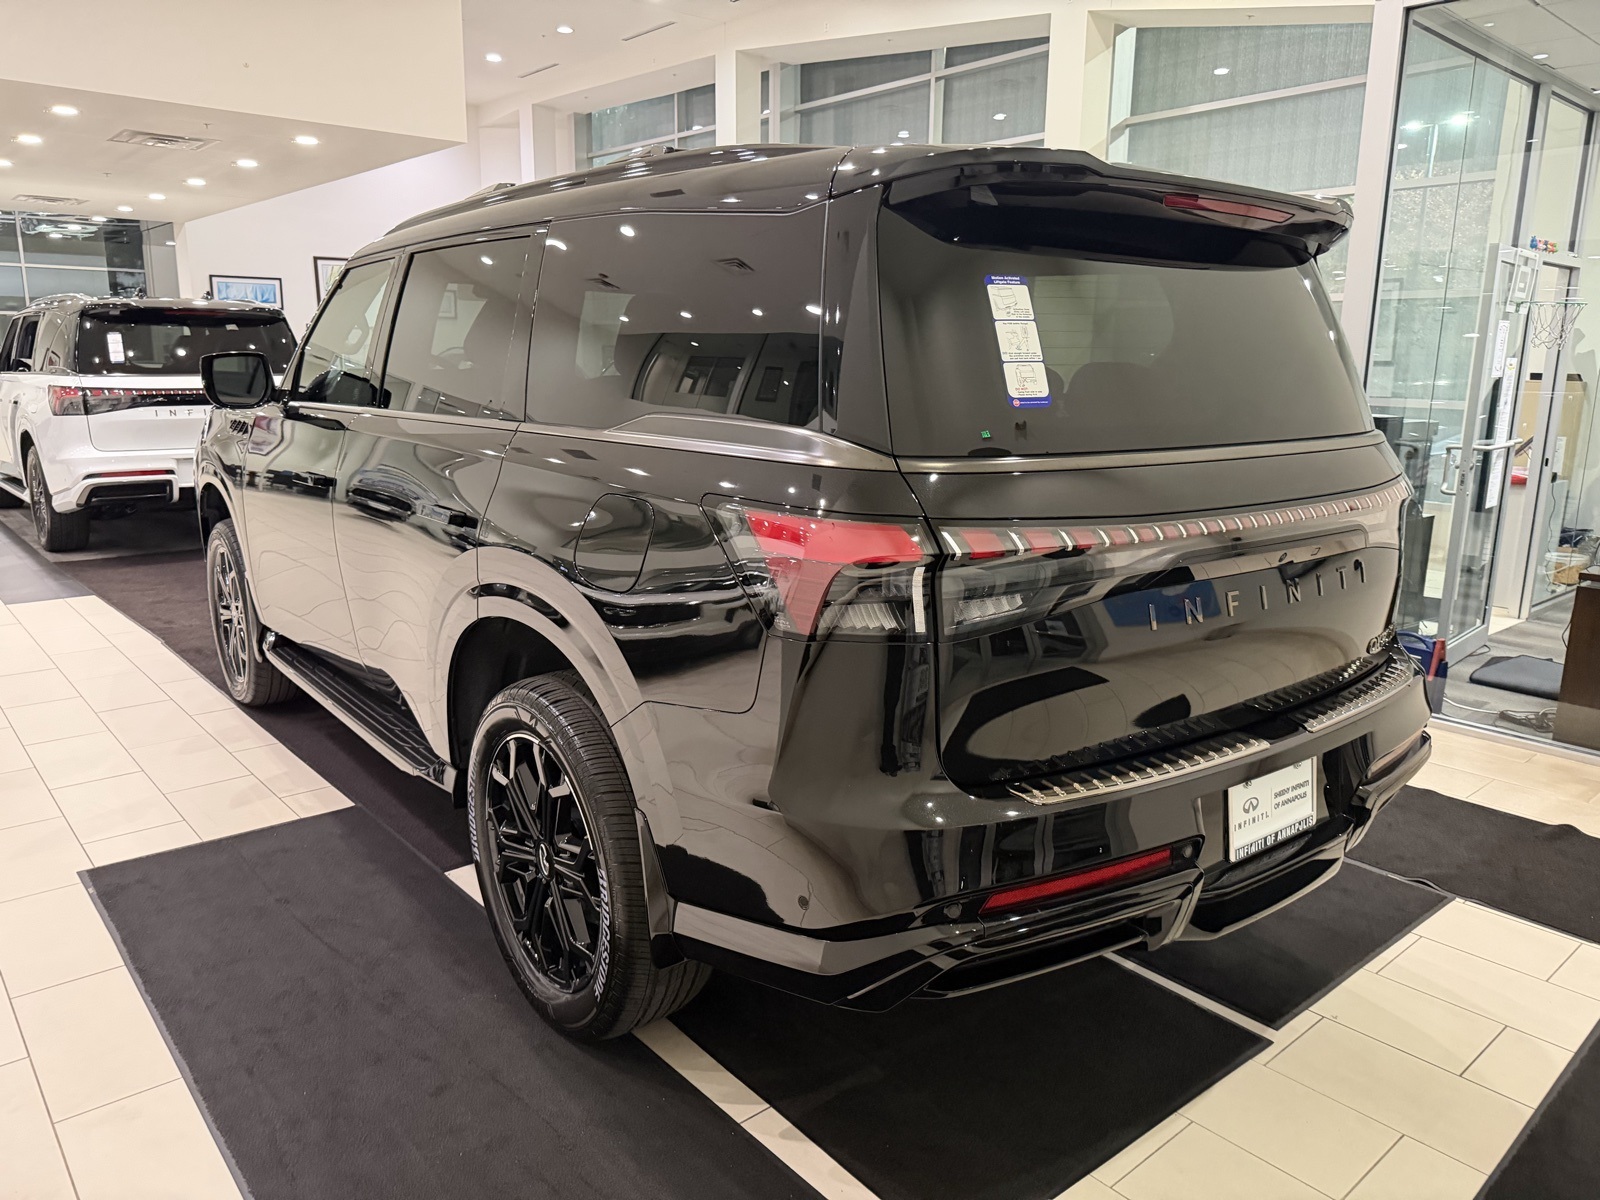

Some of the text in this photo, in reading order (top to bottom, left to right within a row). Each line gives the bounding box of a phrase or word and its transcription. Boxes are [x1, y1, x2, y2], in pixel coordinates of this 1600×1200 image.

[154, 408, 207, 417] INFI
[1148, 560, 1366, 631] INFINITI
[1273, 790, 1308, 810] OF ANNAPOLIS
[1233, 810, 1269, 832] INFINITI
[1236, 815, 1314, 860] INFINITI OF ANNAPOLIS
